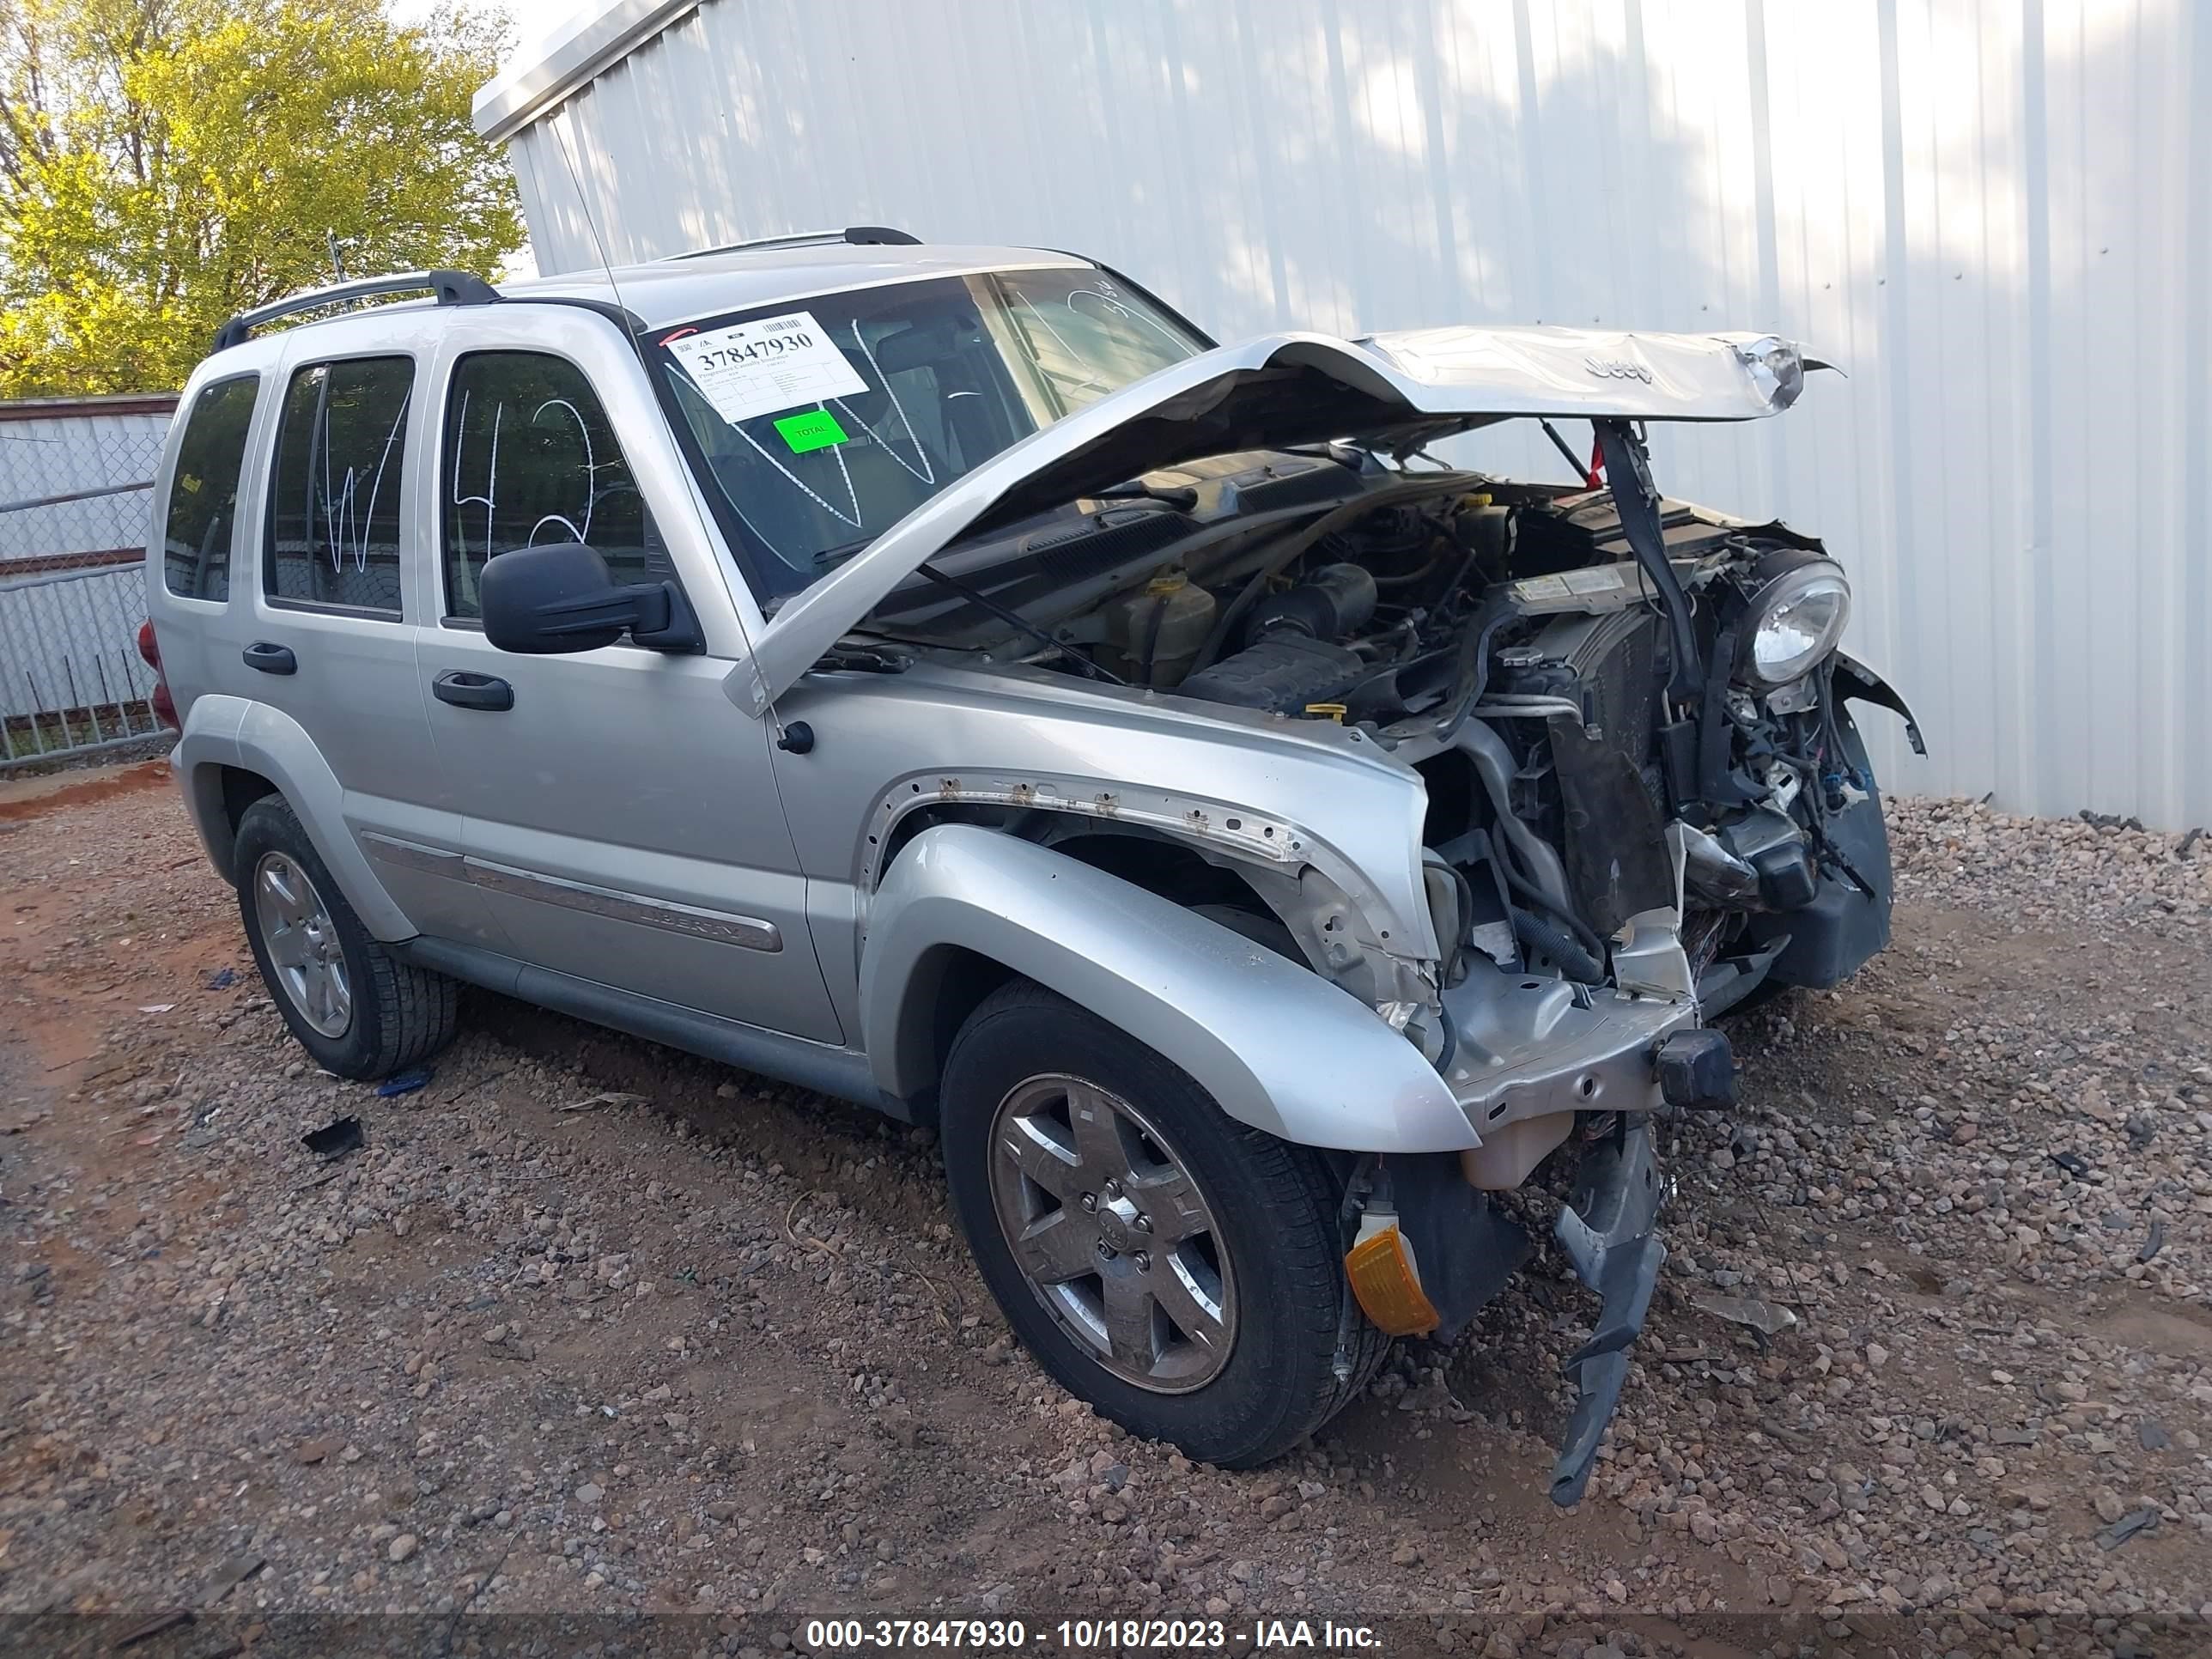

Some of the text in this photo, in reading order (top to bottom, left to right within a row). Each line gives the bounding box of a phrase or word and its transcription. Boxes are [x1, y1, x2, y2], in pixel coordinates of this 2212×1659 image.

[697, 332, 813, 371] 37847930
[794, 425, 829, 438] TOTAL
[640, 912, 741, 939] LIBERTY
